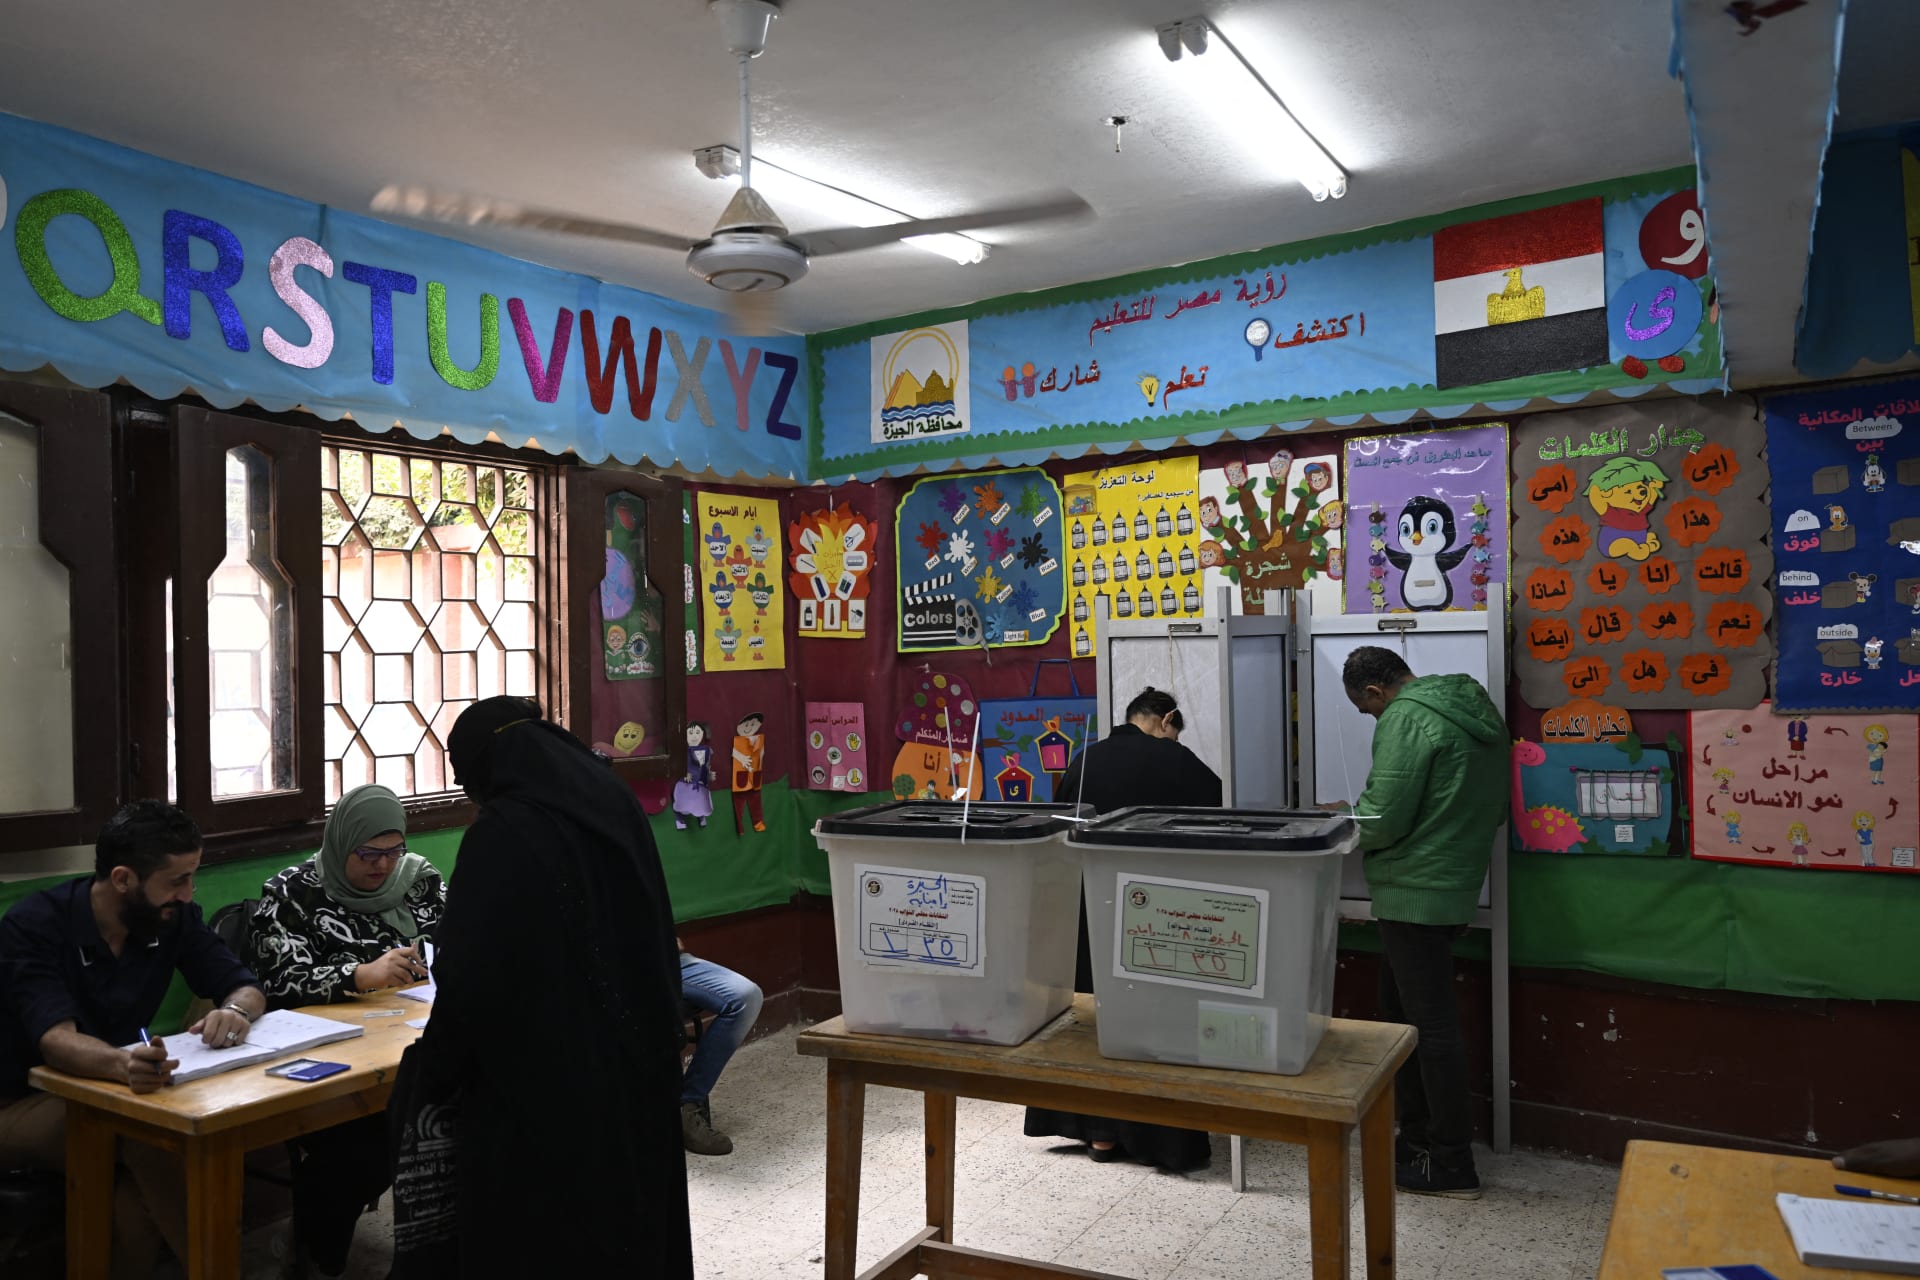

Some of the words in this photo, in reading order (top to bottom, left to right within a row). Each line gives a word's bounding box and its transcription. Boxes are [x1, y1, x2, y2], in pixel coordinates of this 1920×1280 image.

[1234, 273, 1288, 309] رؤية
[1164, 289, 1221, 320] مصر
[1089, 295, 1155, 347] للتعليم
[1274, 313, 1365, 351] اكتشف
[1040, 360, 1100, 393] شارك
[1163, 365, 1209, 410] تعلم
[916, 415, 962, 433] محافظة
[1799, 406, 1863, 431] المكانية
[1852, 423, 1893, 433] Between
[883, 420, 914, 440] الجيزة
[1637, 424, 1705, 456] جدار
[1539, 426, 1628, 460] الكلمات
[1099, 475, 1127, 489] التعزيز
[1131, 470, 1154, 483] لوحة
[991, 504, 1010, 523] Orange
[1034, 510, 1051, 524] Green
[1683, 511, 1710, 530] هذا
[1797, 515, 1809, 523] on
[1553, 528, 1580, 546] هذه
[1783, 532, 1821, 552] فوق
[927, 557, 938, 568] Red
[1041, 560, 1056, 572] Black
[1245, 552, 1292, 580] شجرة
[1699, 560, 1742, 579] قالت
[1599, 568, 1617, 592] يا
[1782, 573, 1813, 582] behind
[1531, 580, 1566, 600] لماذا
[1784, 590, 1821, 606] خلف
[1031, 610, 1045, 620] Blue
[1588, 612, 1621, 638] قال
[1652, 611, 1677, 630] هو
[1718, 615, 1751, 637] نعم
[1820, 629, 1853, 637] outside
[1632, 660, 1657, 681] هل
[1820, 669, 1862, 687] خارج
[1063, 711, 1086, 726] بيت
[1544, 714, 1590, 738] الكلمات
[1593, 713, 1627, 743] تحليل
[915, 727, 942, 744] المتكلم
[923, 751, 941, 773] أنا
[1762, 758, 1829, 782] مراحل
[1733, 790, 1802, 810] الانسان
[1808, 794, 1843, 809] نمو
